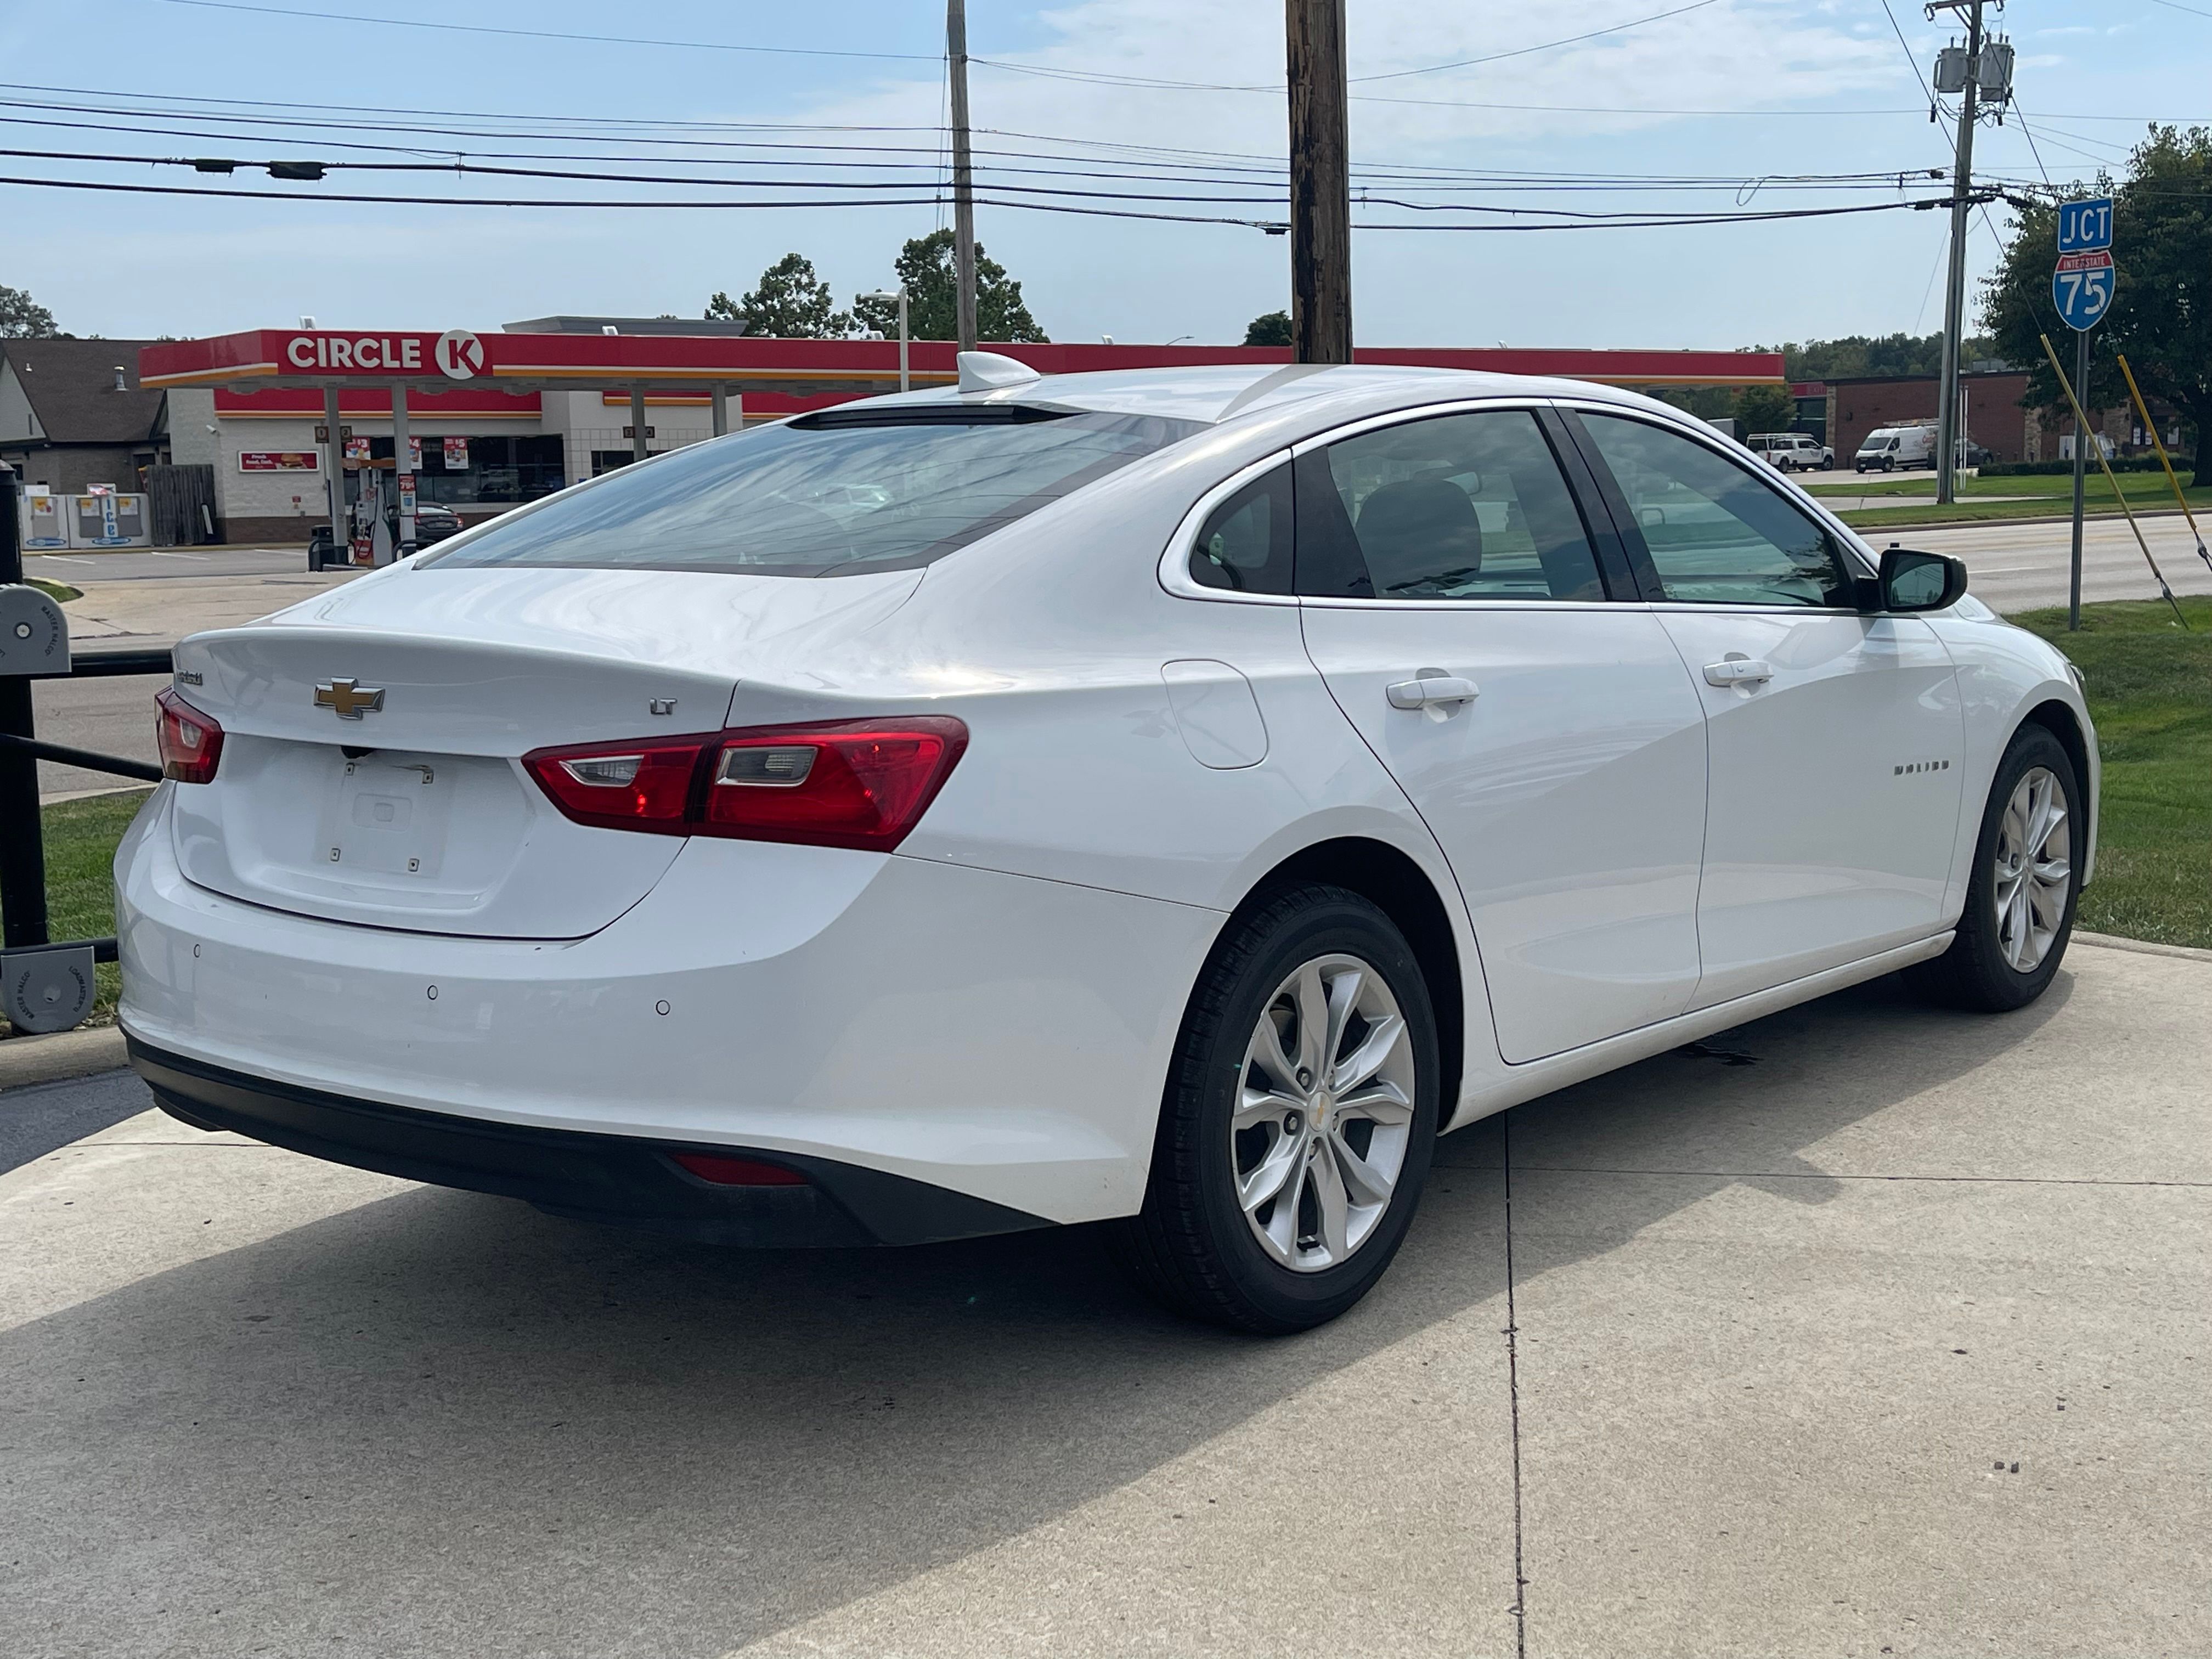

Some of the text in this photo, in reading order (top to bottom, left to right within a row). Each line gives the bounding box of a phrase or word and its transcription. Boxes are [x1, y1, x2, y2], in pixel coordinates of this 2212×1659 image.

[2063, 207, 2109, 244] JCT
[2063, 256, 2106, 270] INTERSTATE
[2060, 271, 2106, 315] 75
[287, 336, 482, 376] CIRCLE K
[650, 698, 677, 715] LT
